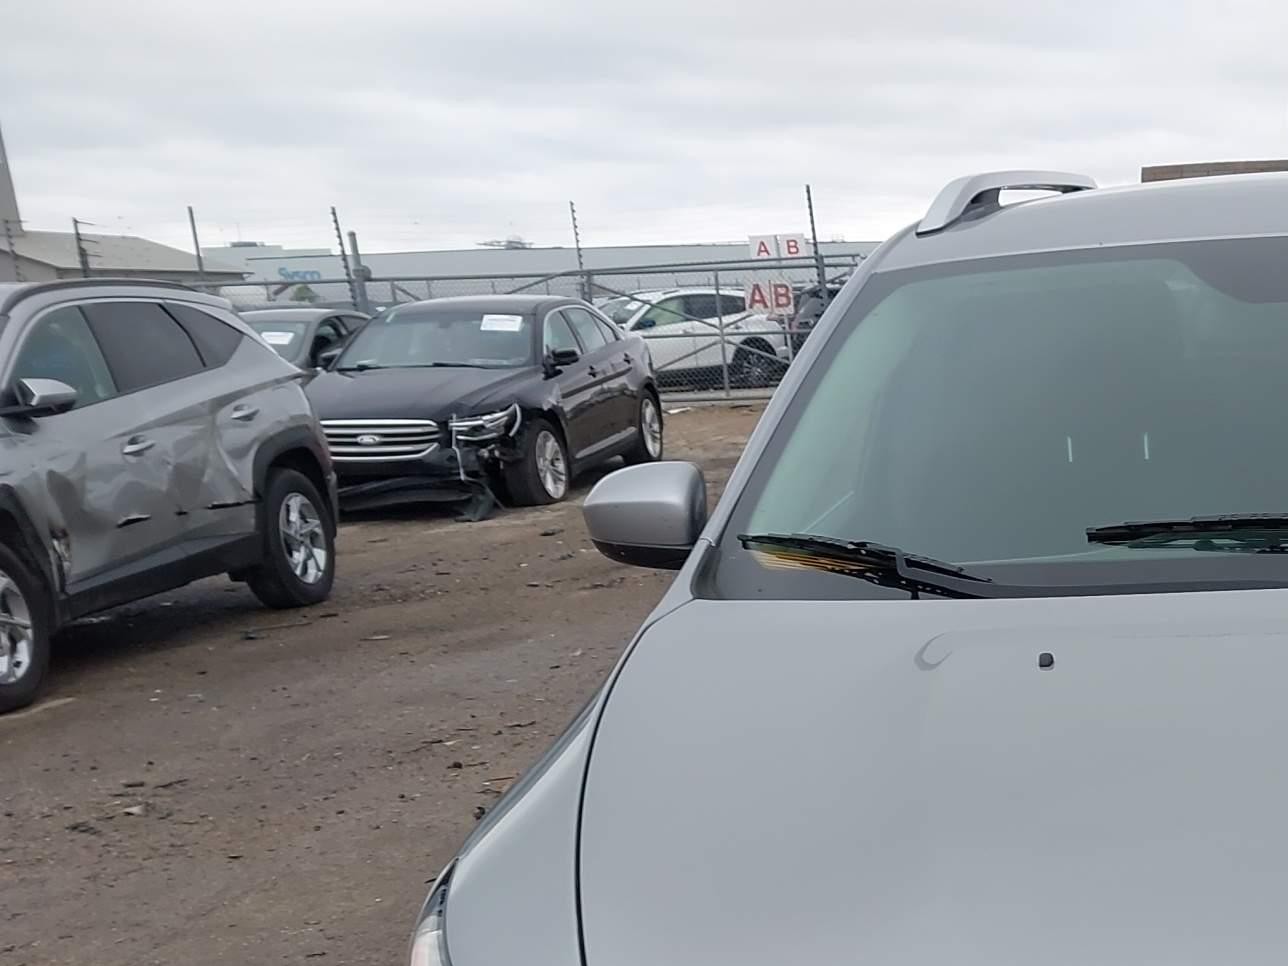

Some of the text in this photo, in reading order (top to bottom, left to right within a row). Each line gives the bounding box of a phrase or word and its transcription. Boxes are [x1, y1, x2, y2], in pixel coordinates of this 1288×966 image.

[757, 239, 799, 256] A B
[749, 284, 791, 309] A B
